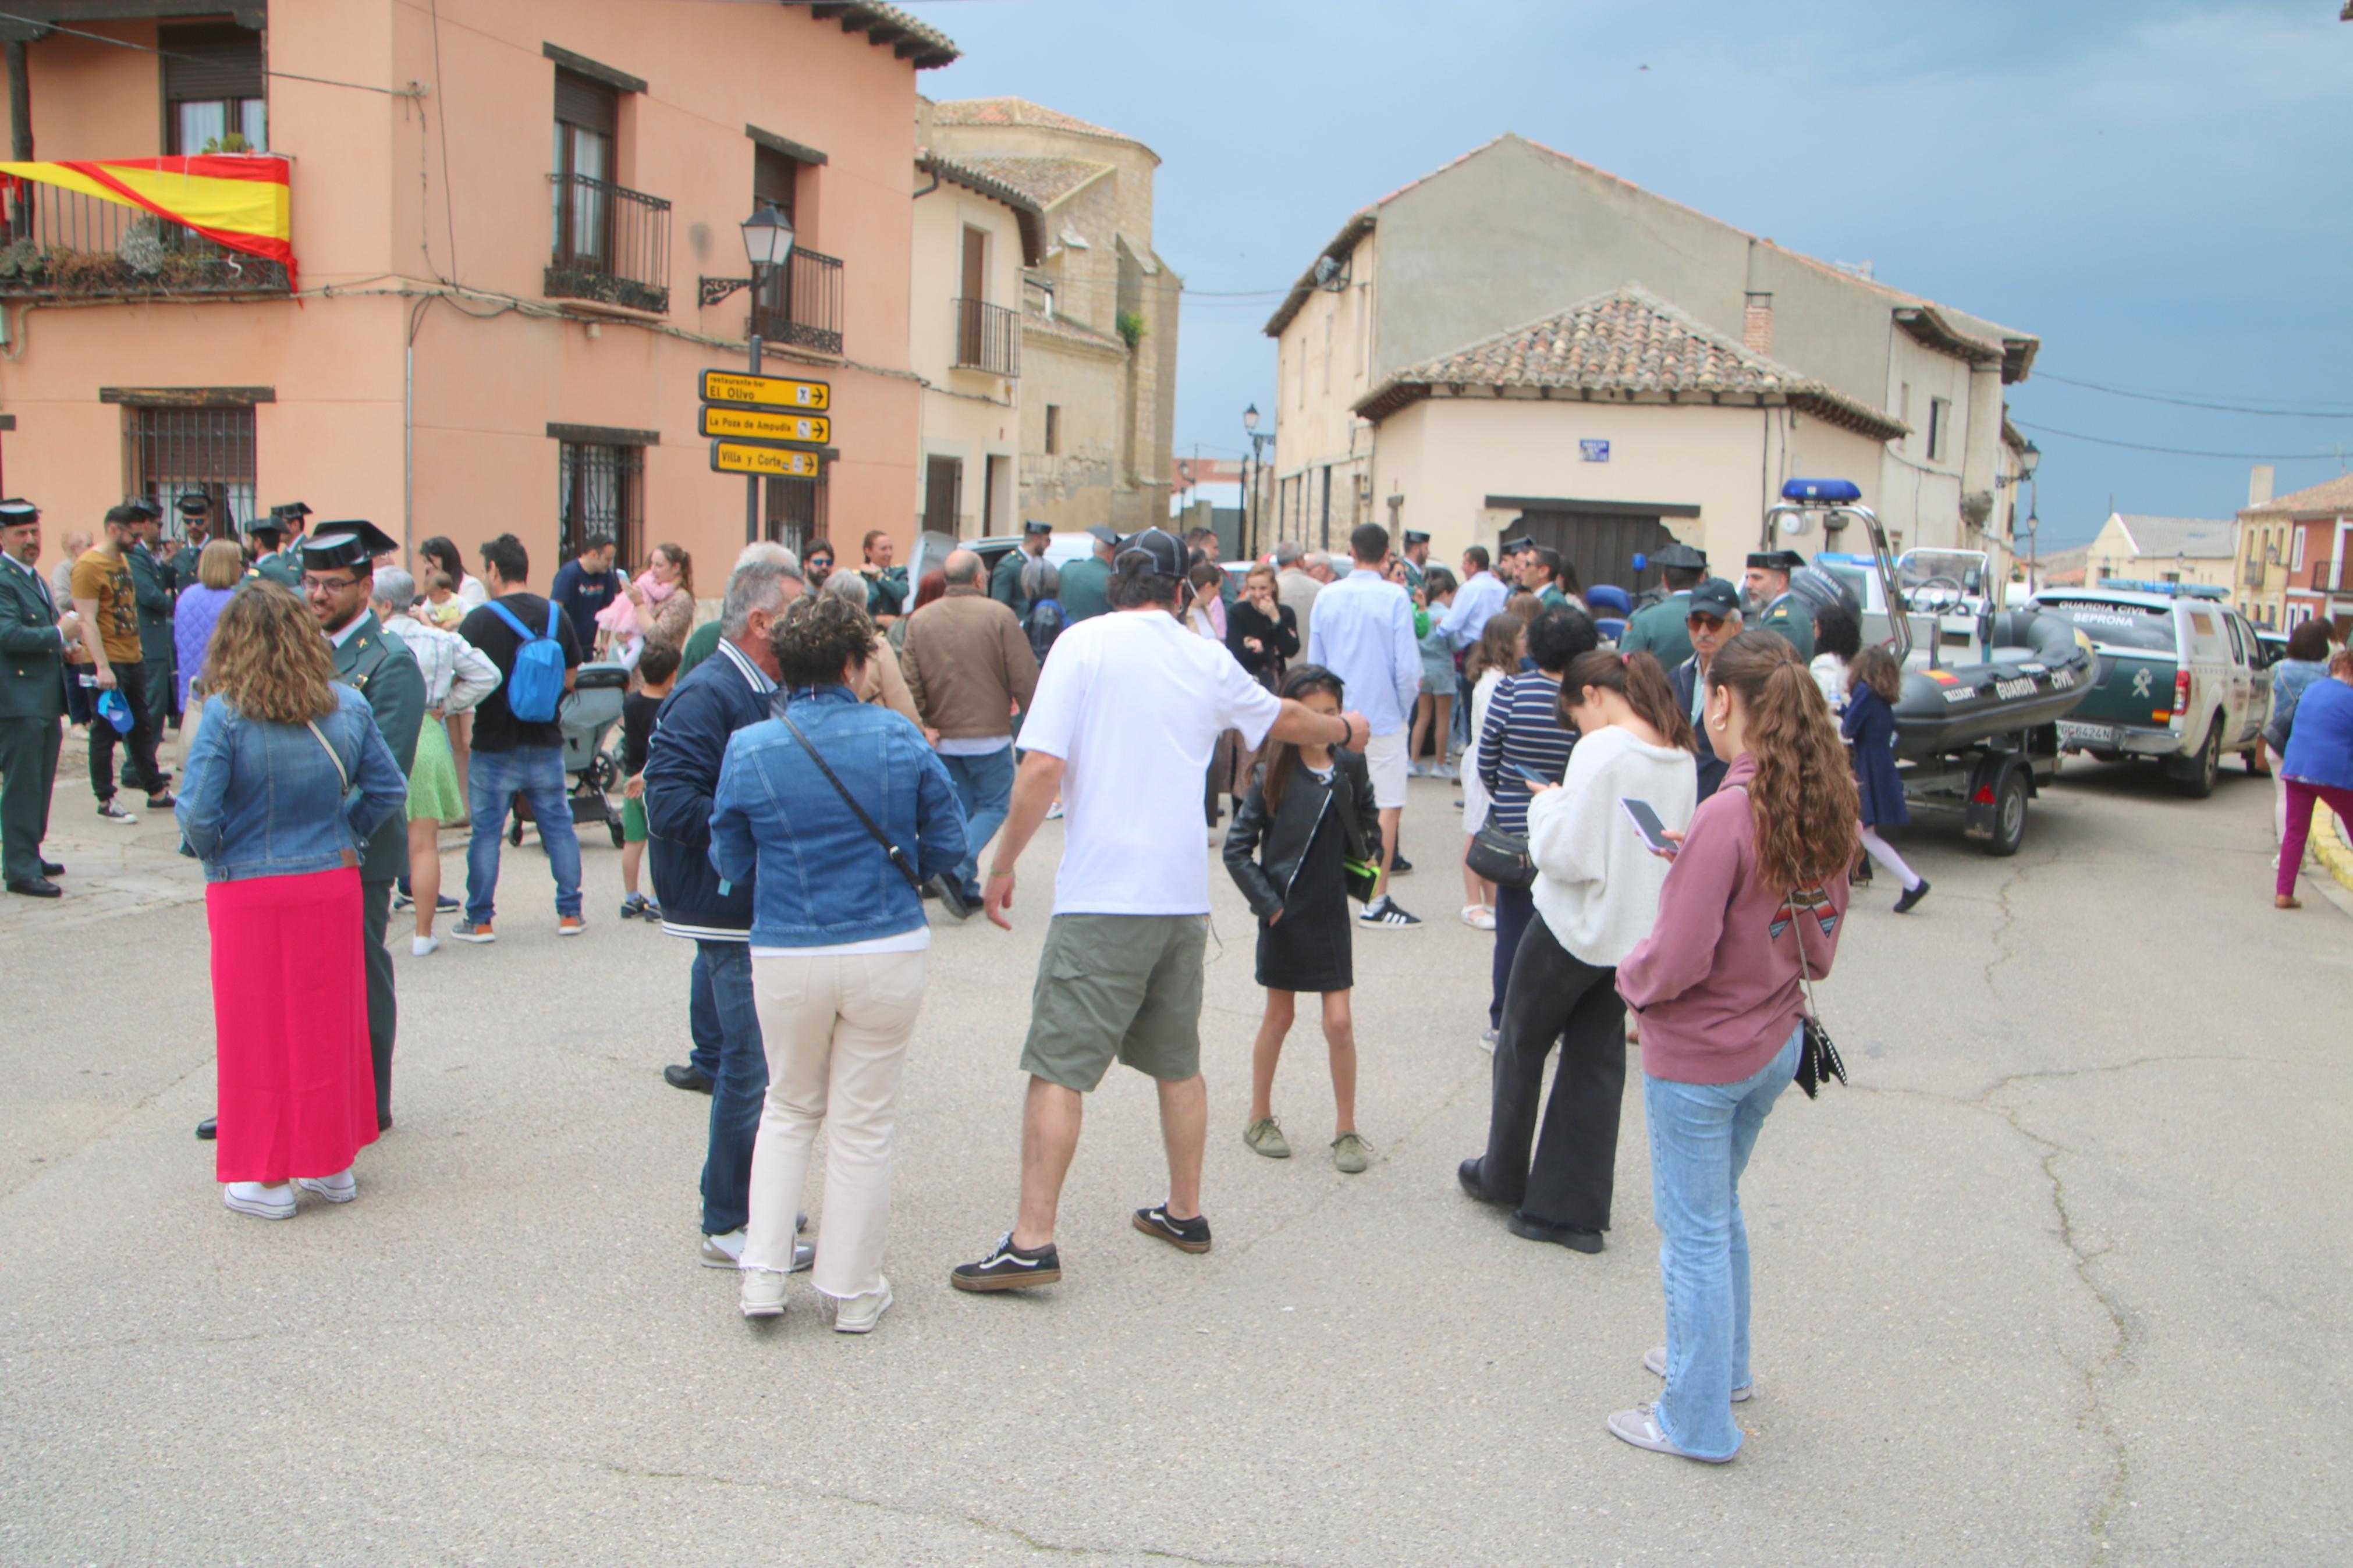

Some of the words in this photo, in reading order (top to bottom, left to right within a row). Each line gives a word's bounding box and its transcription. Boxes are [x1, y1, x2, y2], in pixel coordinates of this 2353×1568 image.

[710, 386, 720, 397] El
[727, 387, 754, 400] Olivo
[709, 417, 719, 426] La
[722, 418, 741, 428] Poza
[744, 420, 754, 429] de
[757, 421, 792, 432] Ampudia
[722, 450, 741, 463] Villa
[747, 456, 753, 465] y
[757, 454, 781, 467] Corte
[2058, 600, 2114, 613] GUARDIA
[2117, 605, 2148, 616] CIVIL
[2072, 612, 2134, 627] SEPRONA
[1996, 677, 2038, 701] GUARDIA
[2051, 670, 2075, 690] CIVIL
